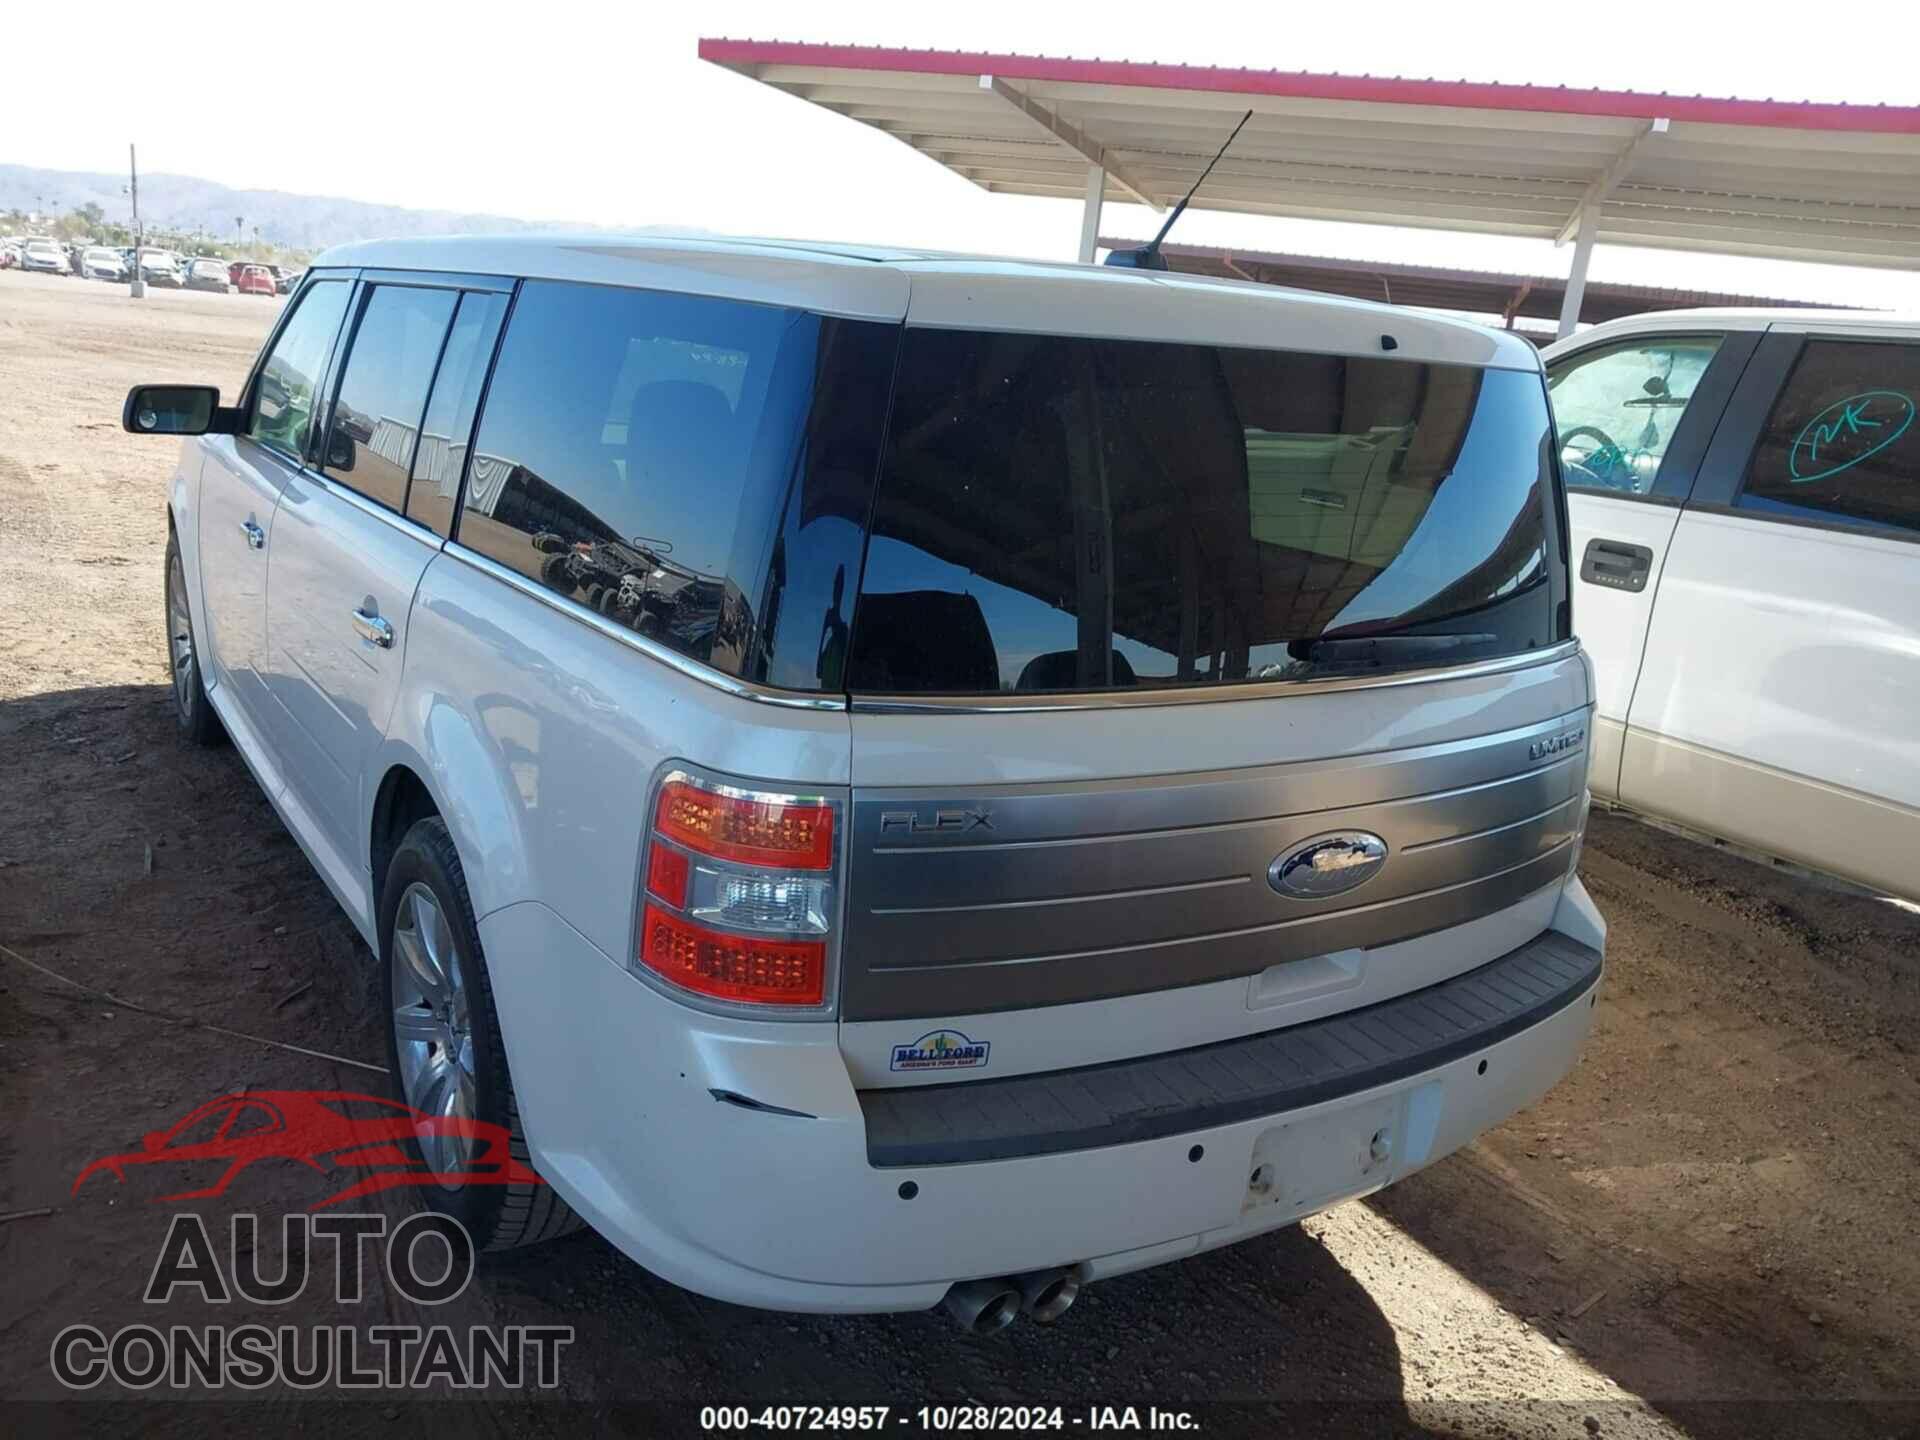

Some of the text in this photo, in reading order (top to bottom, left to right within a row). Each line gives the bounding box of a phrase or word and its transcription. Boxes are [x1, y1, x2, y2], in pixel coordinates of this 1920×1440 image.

[880, 807, 995, 832] FLEX
[896, 1045, 985, 1062] BELL FORD
